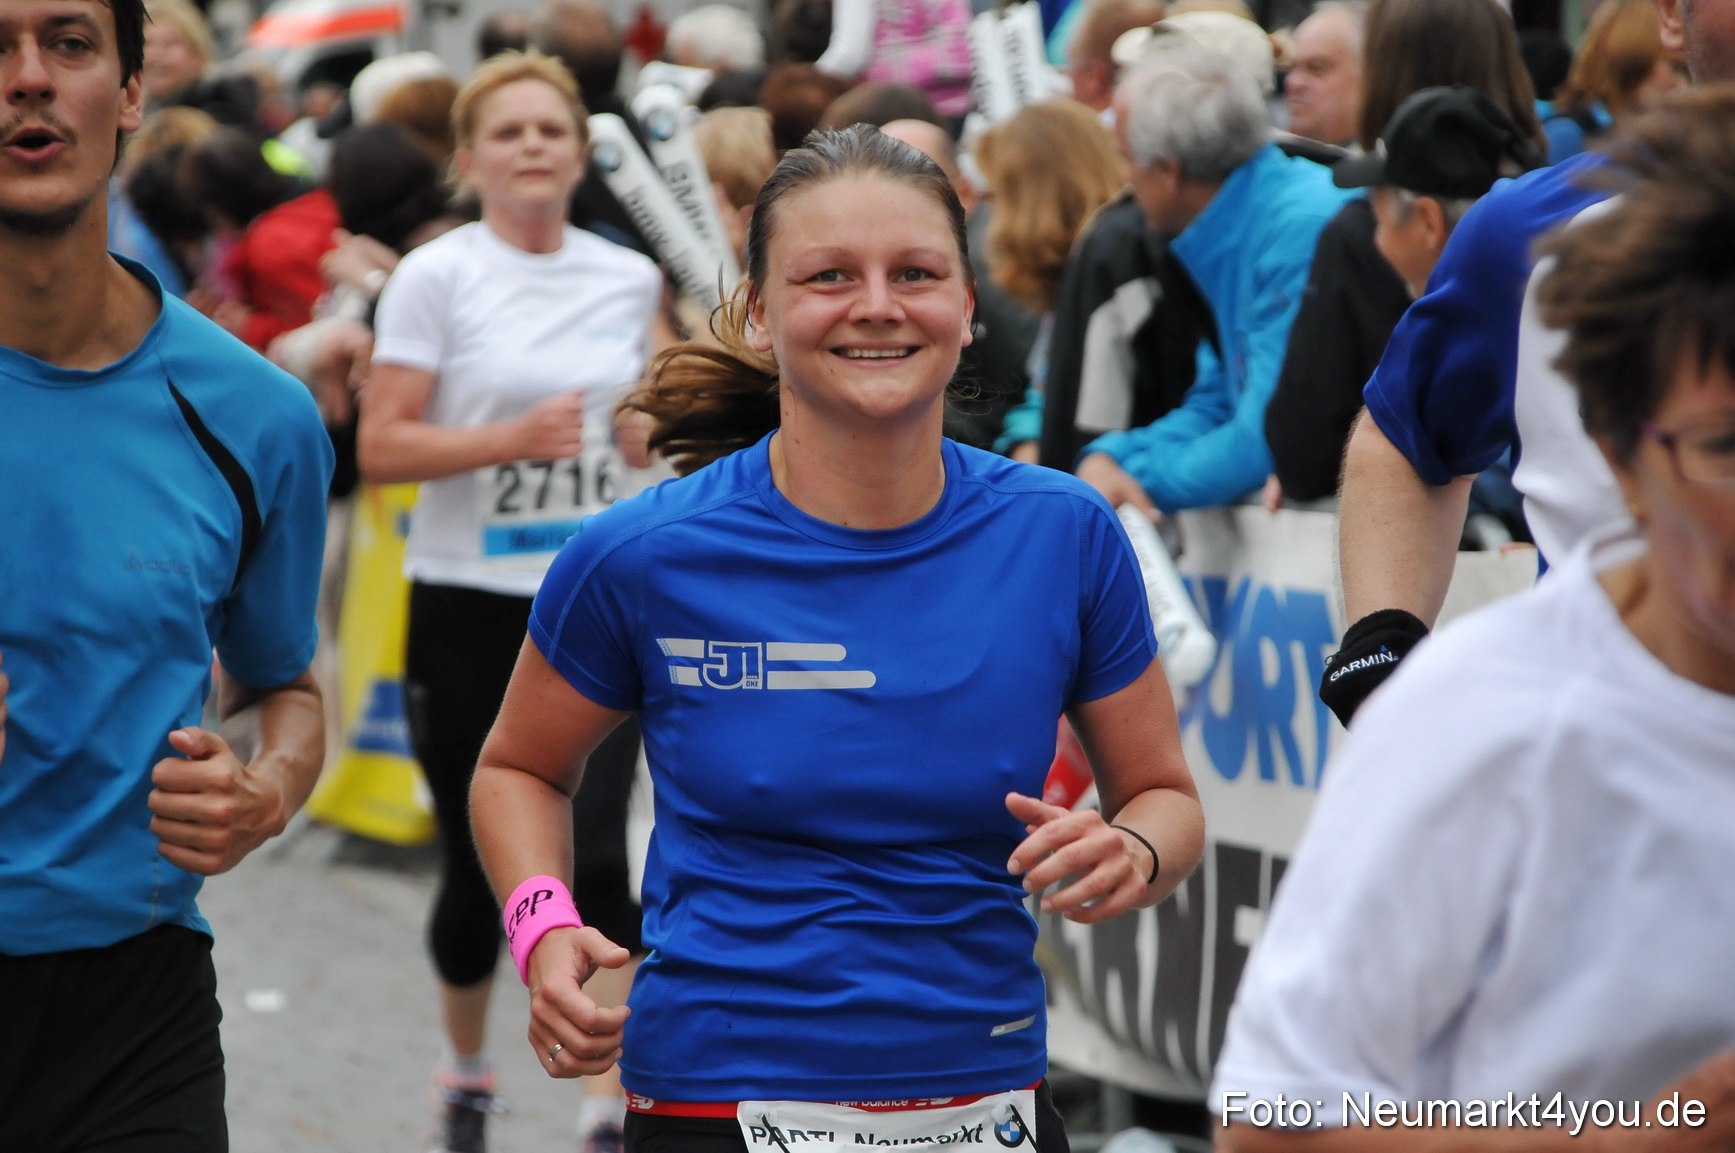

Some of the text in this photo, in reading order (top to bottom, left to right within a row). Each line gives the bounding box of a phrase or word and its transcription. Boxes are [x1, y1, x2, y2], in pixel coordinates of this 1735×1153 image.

[496, 458, 622, 513] 2716
[1329, 651, 1395, 682] GARMIN
[508, 889, 554, 944] cep
[861, 1099, 909, 1108] balance
